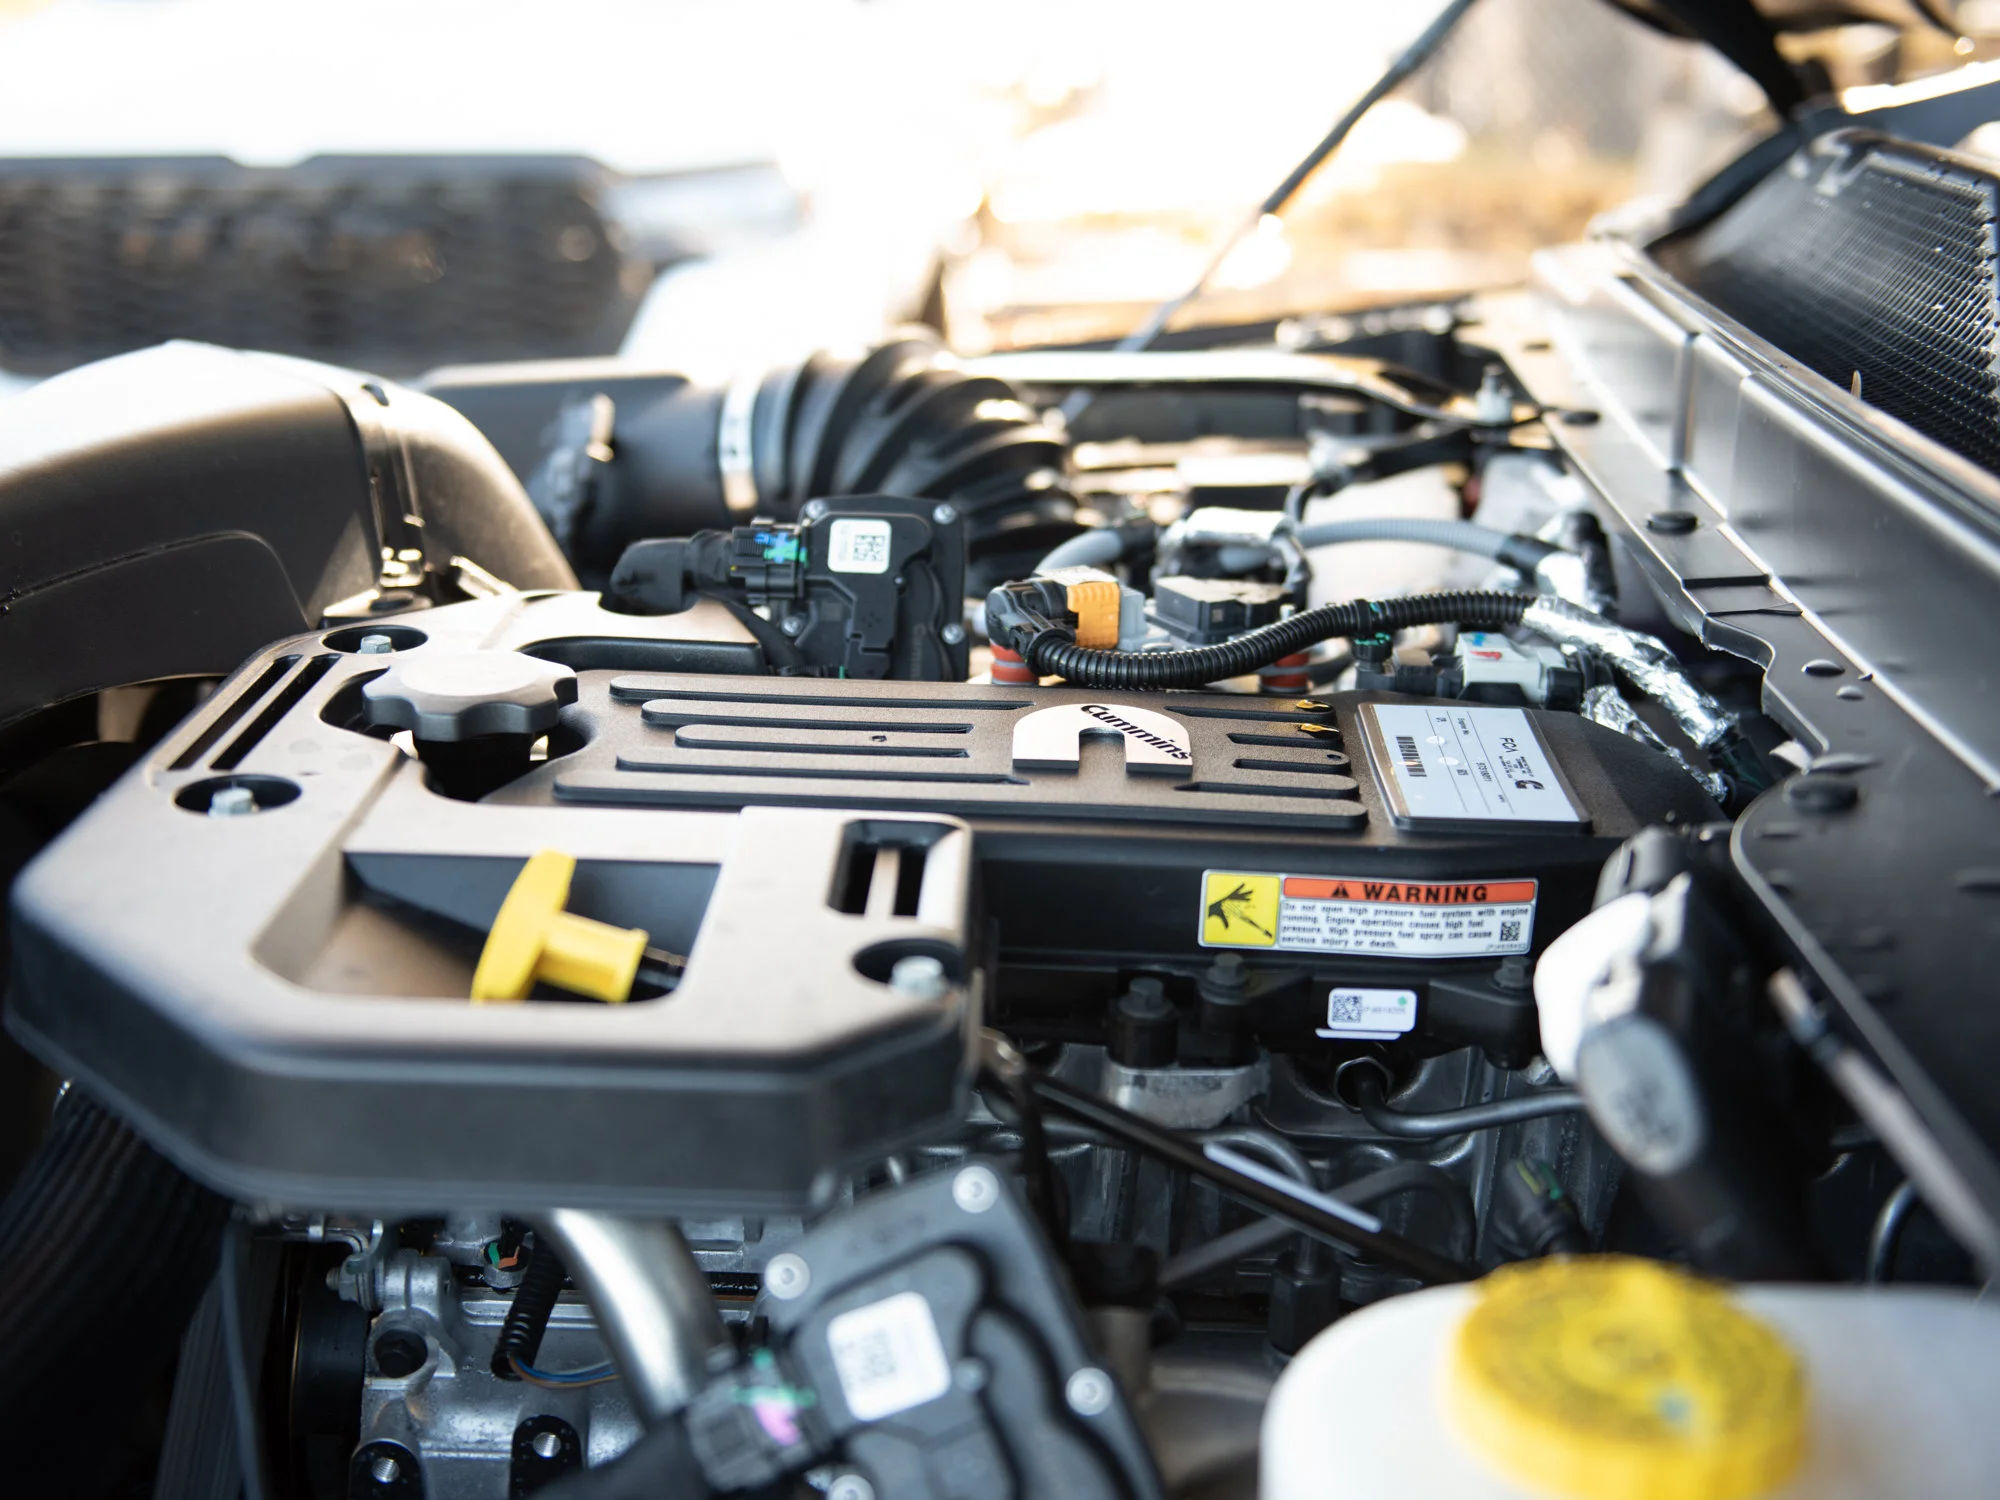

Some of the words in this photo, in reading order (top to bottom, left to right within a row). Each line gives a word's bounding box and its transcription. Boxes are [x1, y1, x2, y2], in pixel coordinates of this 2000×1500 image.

[1081, 705, 1189, 759] Cummins
[1364, 884, 1488, 903] WARNING
[1321, 906, 1343, 914] open
[1349, 907, 1368, 915] high
[1374, 908, 1414, 917] pressure
[1500, 907, 1528, 917] engine
[1325, 916, 1355, 925] Engine
[1361, 918, 1404, 927] operation
[1445, 920, 1463, 930] high
[1468, 919, 1484, 928] fuel
[1329, 927, 1348, 936] High
[1354, 929, 1393, 938] pressure
[1398, 930, 1415, 938] fuel
[1420, 932, 1443, 941] spray
[1468, 931, 1492, 939] cause
[1282, 936, 1316, 944] serious
[1322, 936, 1348, 947] injury
